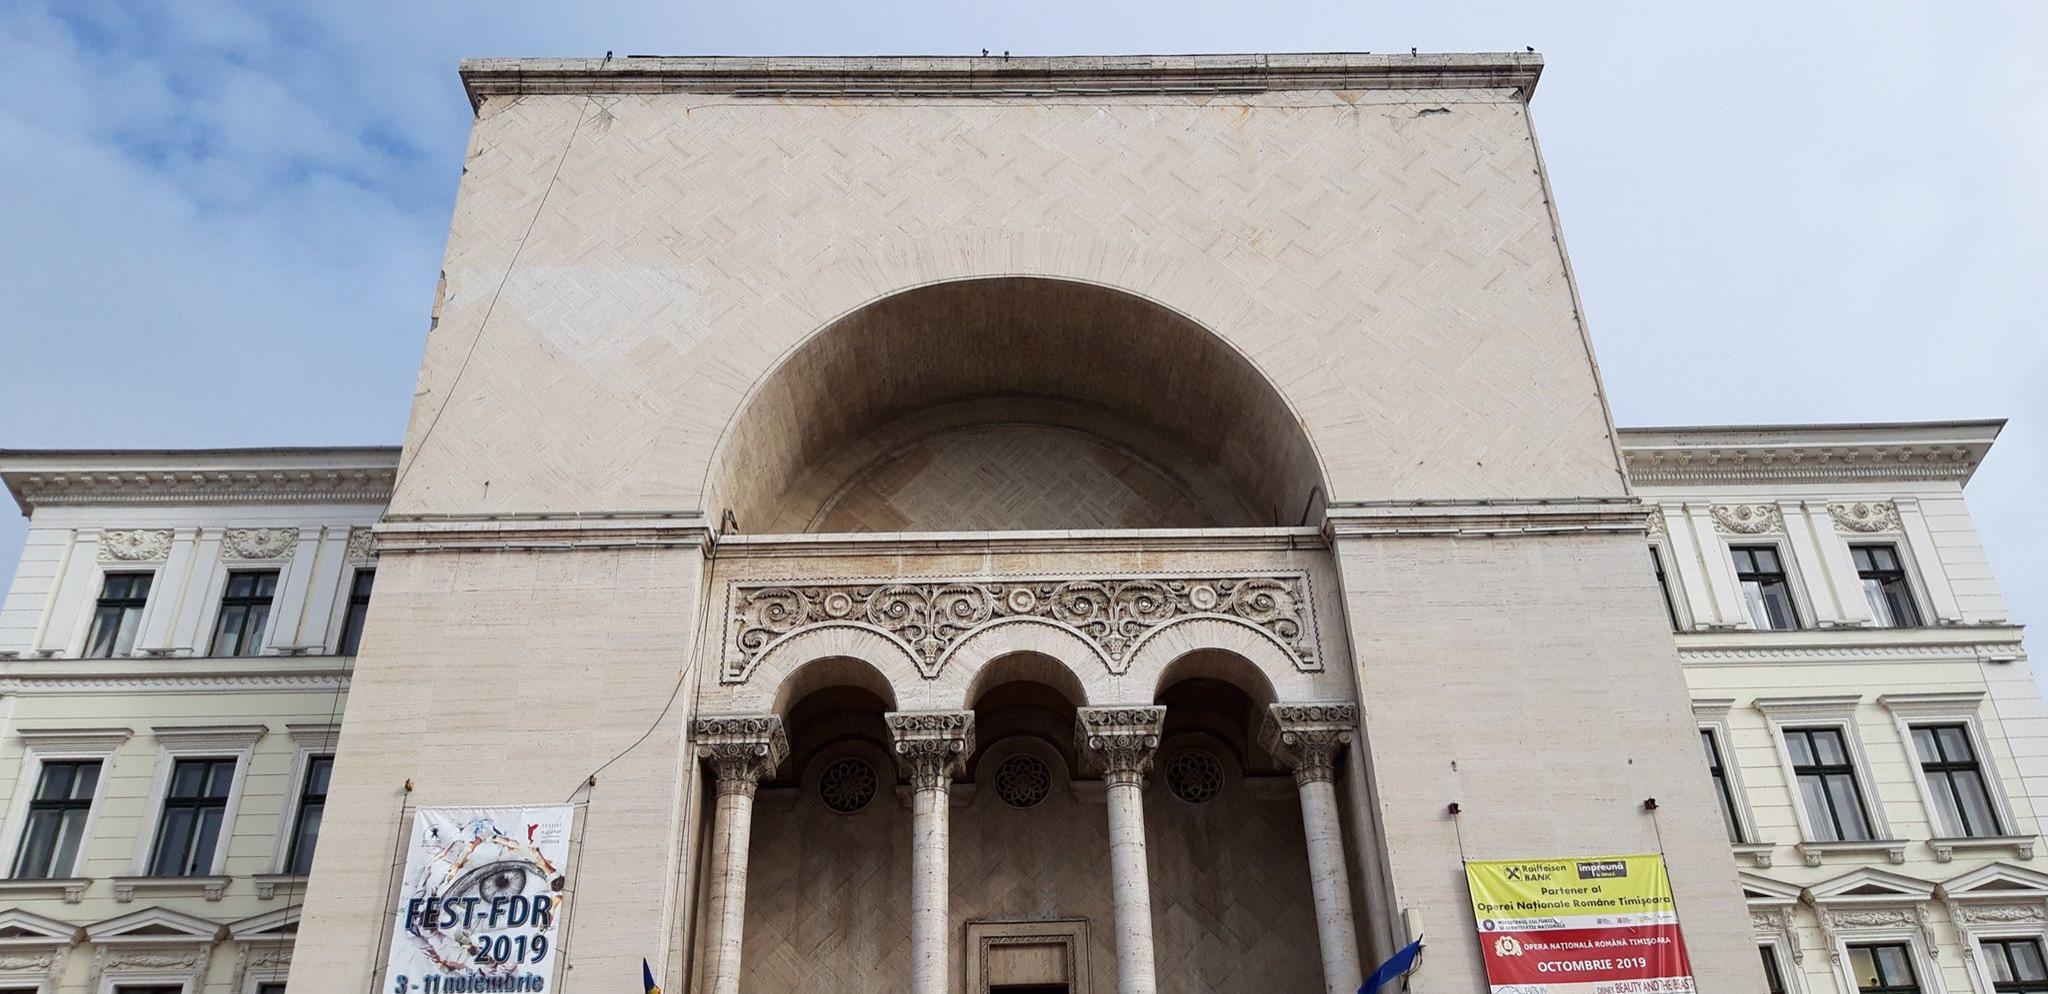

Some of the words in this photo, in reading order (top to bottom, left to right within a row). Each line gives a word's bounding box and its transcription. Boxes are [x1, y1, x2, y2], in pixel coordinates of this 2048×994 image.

[1521, 864, 1567, 872] Raiffeisen
[1524, 873, 1552, 881] BANK
[1541, 886, 1588, 895] Partener
[1591, 885, 1602, 893] al
[405, 894, 553, 930] FEST-FDR
[1477, 901, 1514, 913] Operei
[1573, 898, 1616, 908] Române
[474, 934, 549, 964] 2019
[1538, 960, 1613, 972] OCTOMBRIE
[1616, 957, 1646, 968] 2019
[395, 974, 409, 994] 3
[423, 973, 441, 994] 11
[443, 971, 544, 993] noiembrie
[1615, 982, 1642, 993] BEAUTY
[1644, 980, 1660, 992] AND
